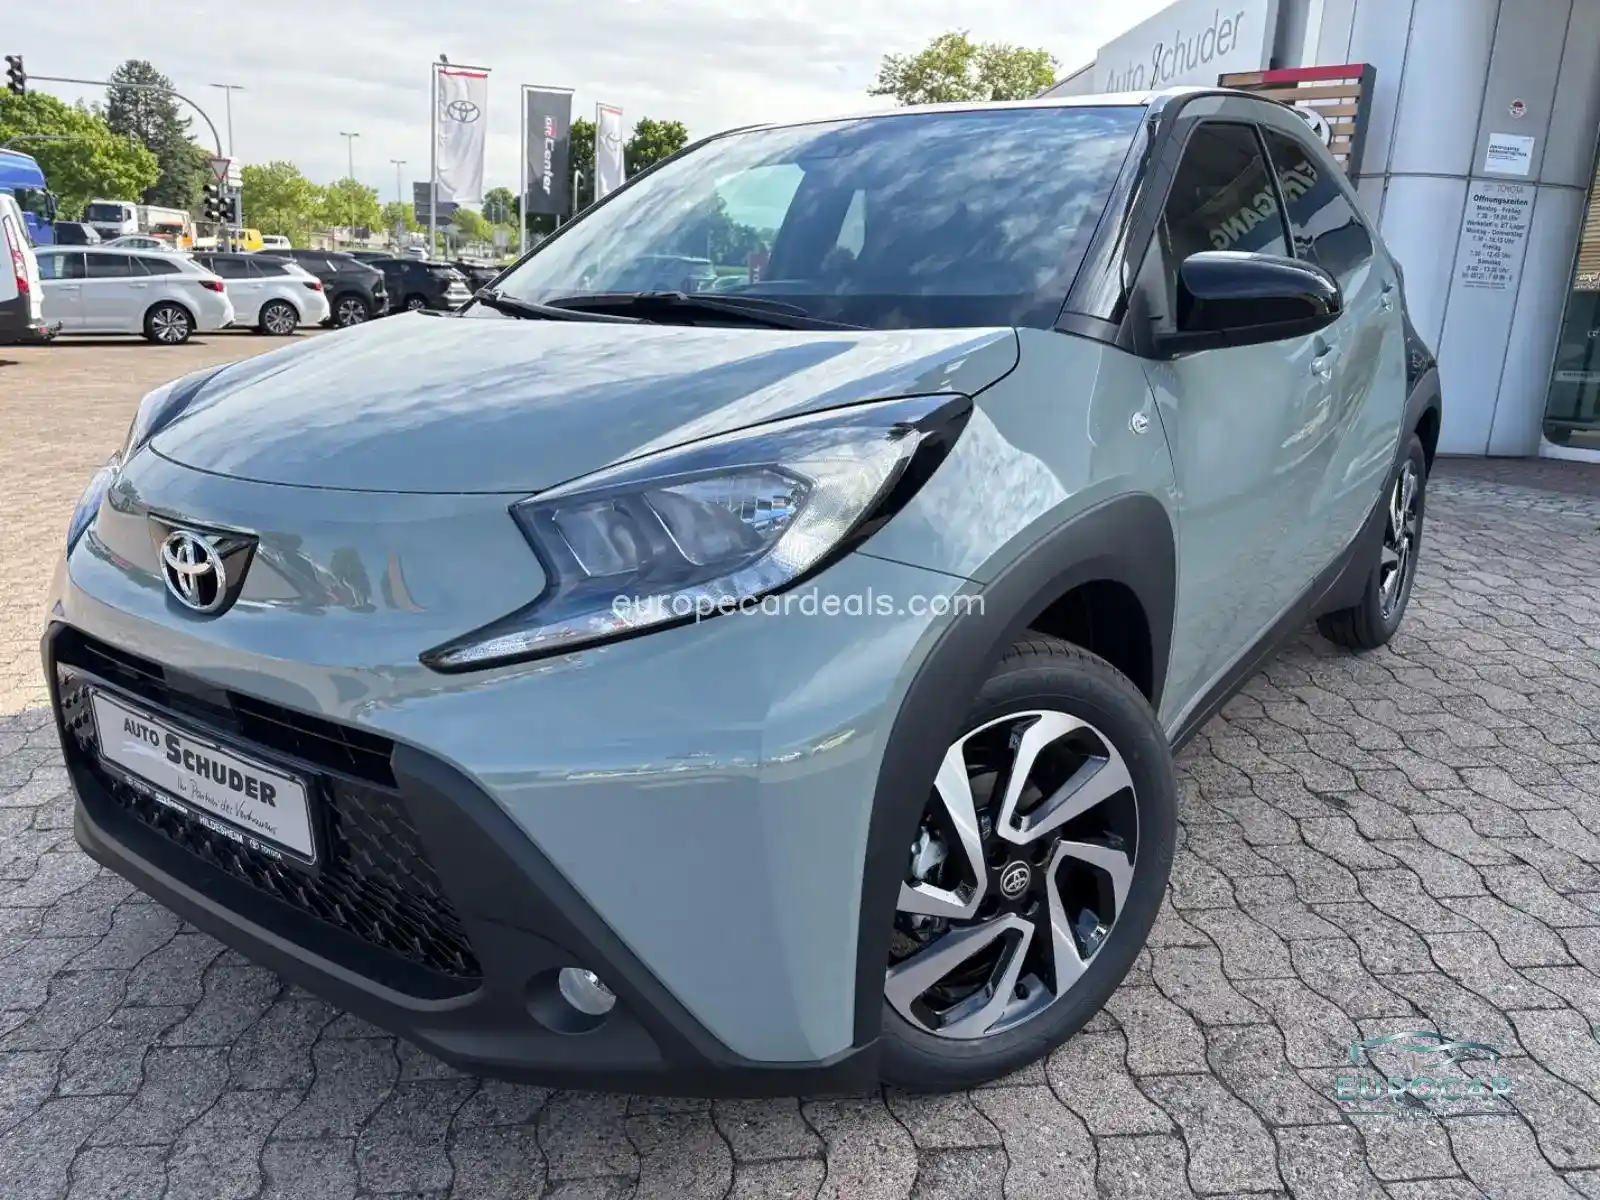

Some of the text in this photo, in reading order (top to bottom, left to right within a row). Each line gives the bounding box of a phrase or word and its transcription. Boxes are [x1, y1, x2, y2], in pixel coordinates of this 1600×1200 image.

[1107, 8, 1245, 93] Auto Schuder
[543, 137, 555, 195] Center
[124, 717, 160, 747] AUTO
[165, 733, 277, 807] SCHUDER
[199, 815, 244, 845] HILDESHEIM
